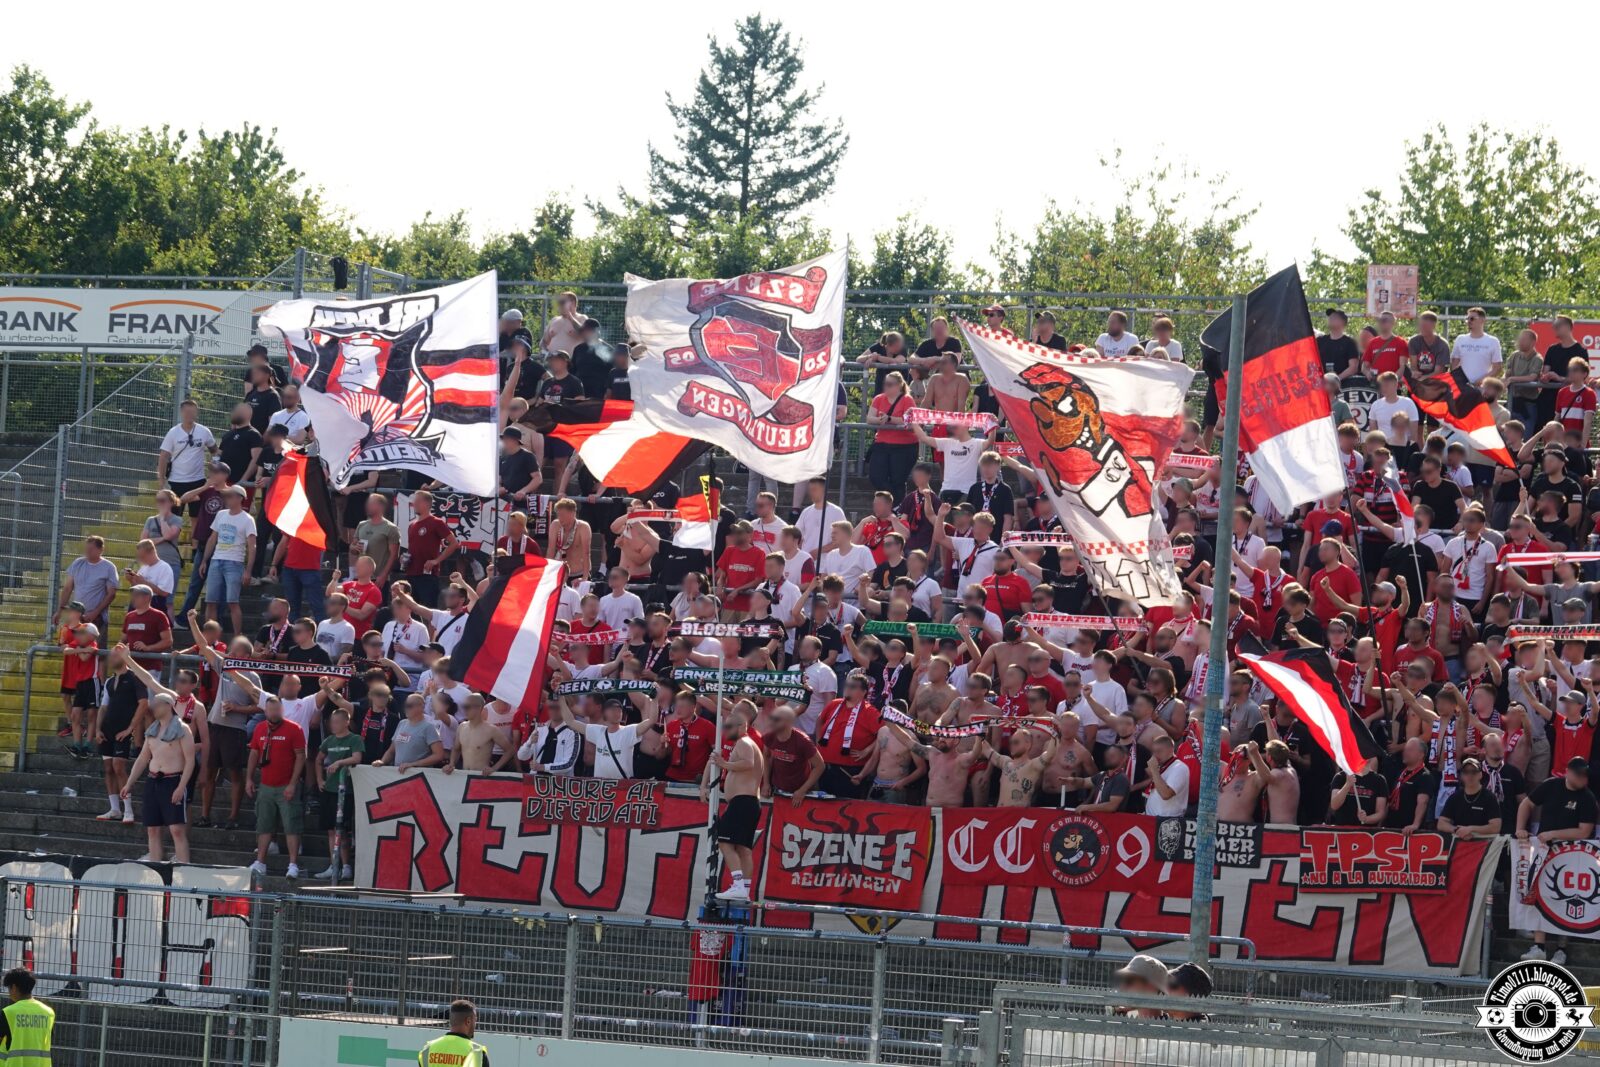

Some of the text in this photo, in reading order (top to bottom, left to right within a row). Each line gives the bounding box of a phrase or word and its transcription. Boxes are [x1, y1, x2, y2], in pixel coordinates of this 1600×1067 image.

[108, 313, 221, 335] FRANK
[0, 333, 78, 343] udetechnik
[107, 335, 221, 348] Gebäudetenik
[1021, 533, 1074, 543] STUTTG
[1025, 612, 1105, 624] ANNSTATTER
[681, 623, 739, 638] BLOCK
[916, 624, 957, 635] ALLEN
[557, 680, 659, 694] REEN POW
[745, 673, 801, 686] GALLEN
[762, 686, 806, 700] POWER
[626, 780, 656, 805] AI
[1050, 815, 1104, 835] Commando
[1218, 822, 1257, 838] BIST
[1100, 845, 1110, 855] 97
[1185, 834, 1256, 853] IMER
[781, 822, 917, 881] SZENE E
[1216, 851, 1256, 866] UNS!
[1304, 831, 1444, 875] TPSP
[1051, 868, 1099, 886] Cannstatt
[1309, 871, 1436, 887] NO A LA AUTORIDAD
[1564, 871, 1591, 891] CO
[16, 1014, 49, 1028] SECURITY
[429, 1052, 467, 1066] SECURITY
